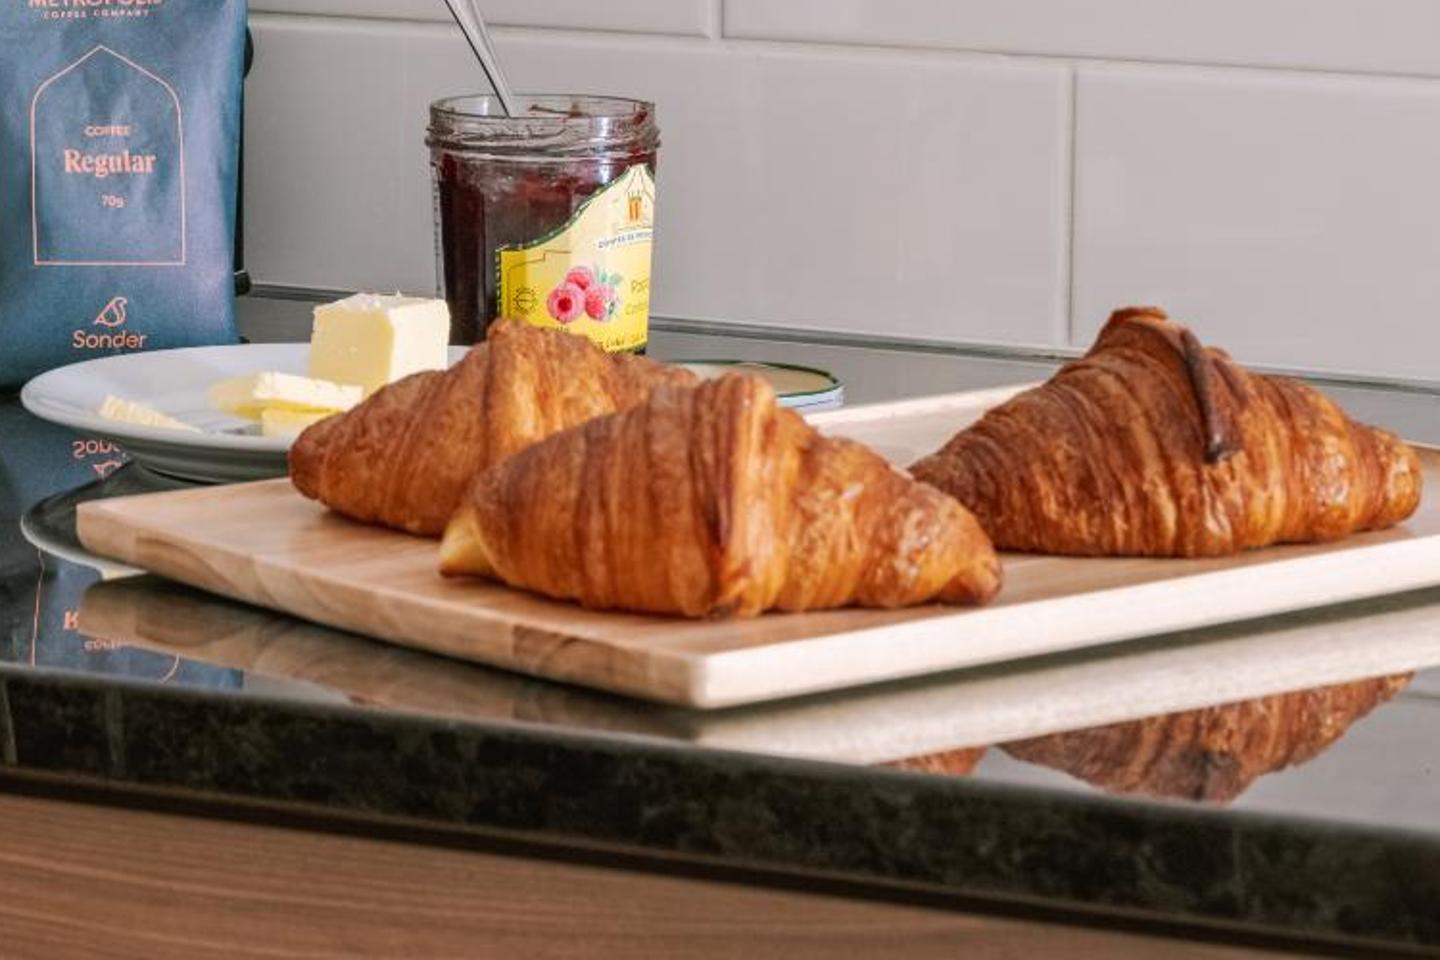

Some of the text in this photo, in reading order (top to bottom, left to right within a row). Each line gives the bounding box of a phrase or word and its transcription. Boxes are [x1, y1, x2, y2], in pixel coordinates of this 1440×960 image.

[43, 8, 150, 19] COFFEE COMPANY
[63, 149, 157, 178] Regular
[101, 194, 125, 209] 70g
[71, 329, 148, 350] Sonder
